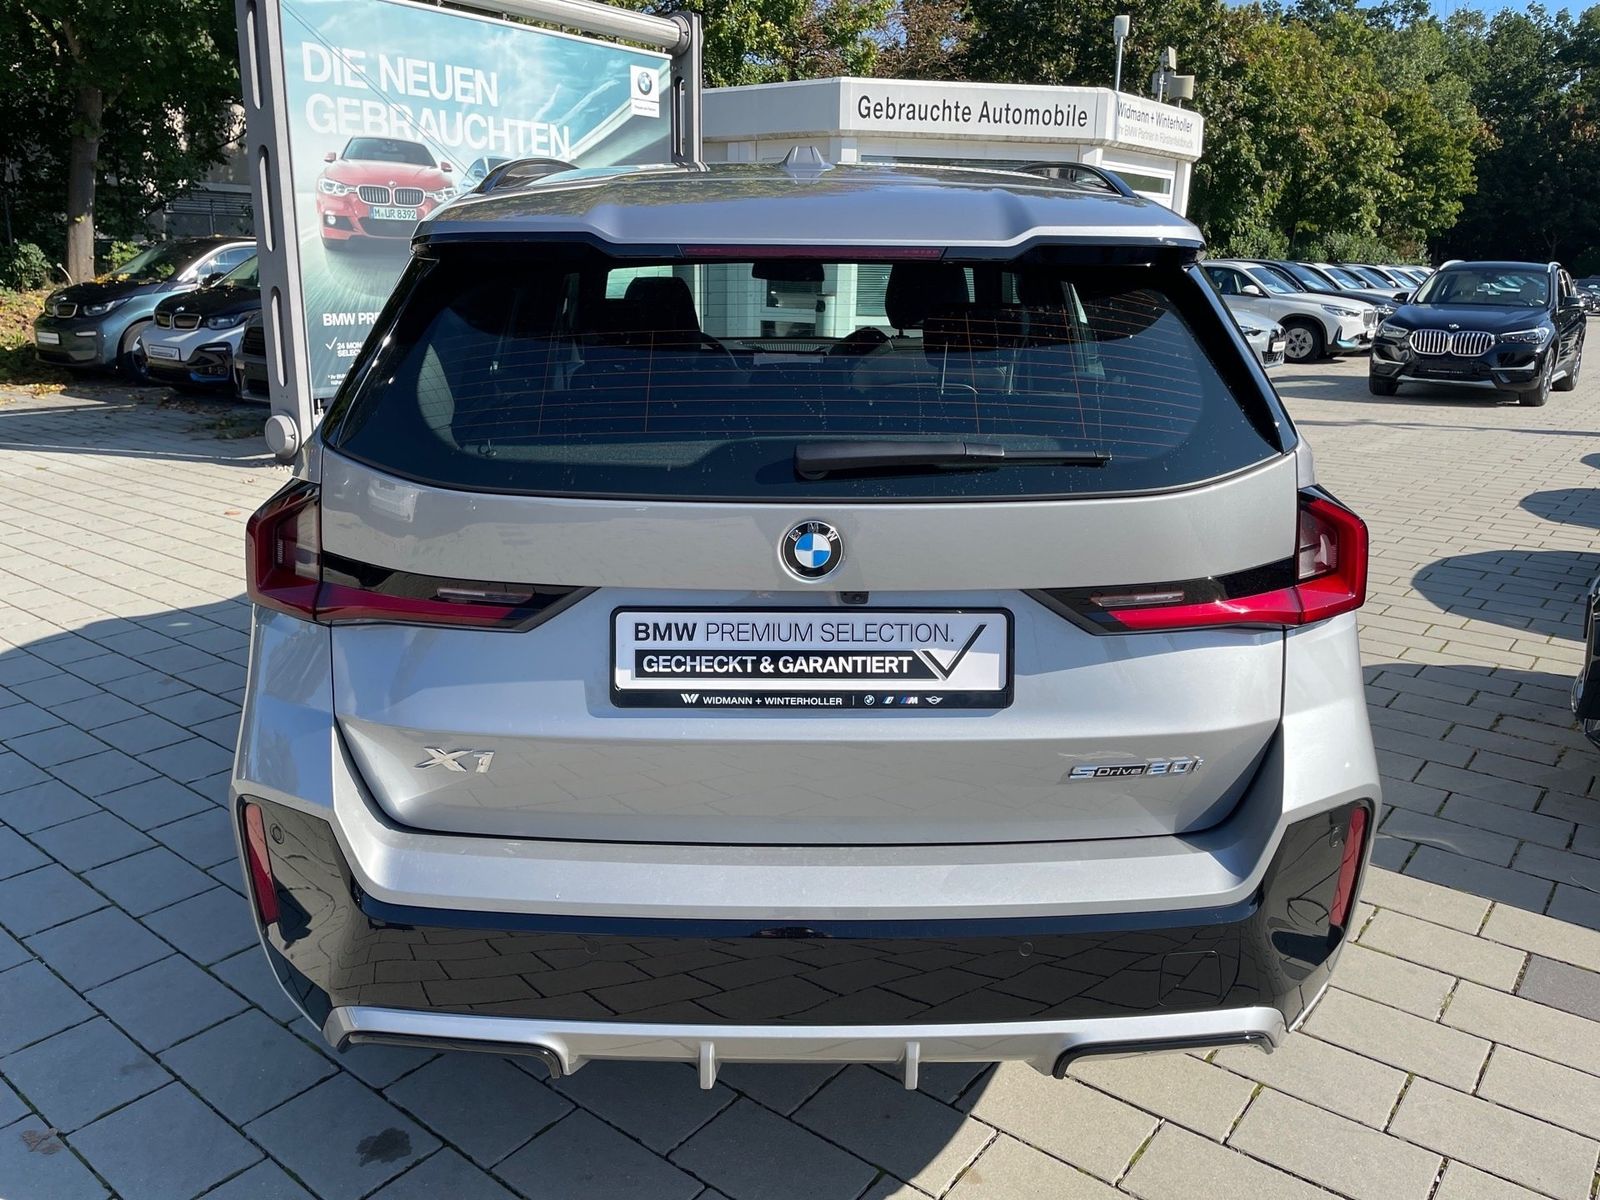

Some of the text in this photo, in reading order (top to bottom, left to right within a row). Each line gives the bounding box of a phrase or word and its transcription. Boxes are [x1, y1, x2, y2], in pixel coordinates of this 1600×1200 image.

[301, 41, 498, 107] DIE NEUEN
[857, 95, 1088, 127] Gebrauchte Automobile
[1117, 100, 1150, 124] Widmann
[1156, 111, 1193, 134] Winterholler
[397, 210, 416, 219] 8392
[322, 312, 356, 327] BMW
[337, 349, 361, 357] SELEC
[634, 622, 954, 643] BMW PREMIUM SELECTION.
[642, 655, 913, 674] GECHECKT & GARANTIERT
[703, 696, 753, 705] WIDMANN
[764, 697, 843, 706] WINTERHOLLER
[415, 747, 495, 773] X1
